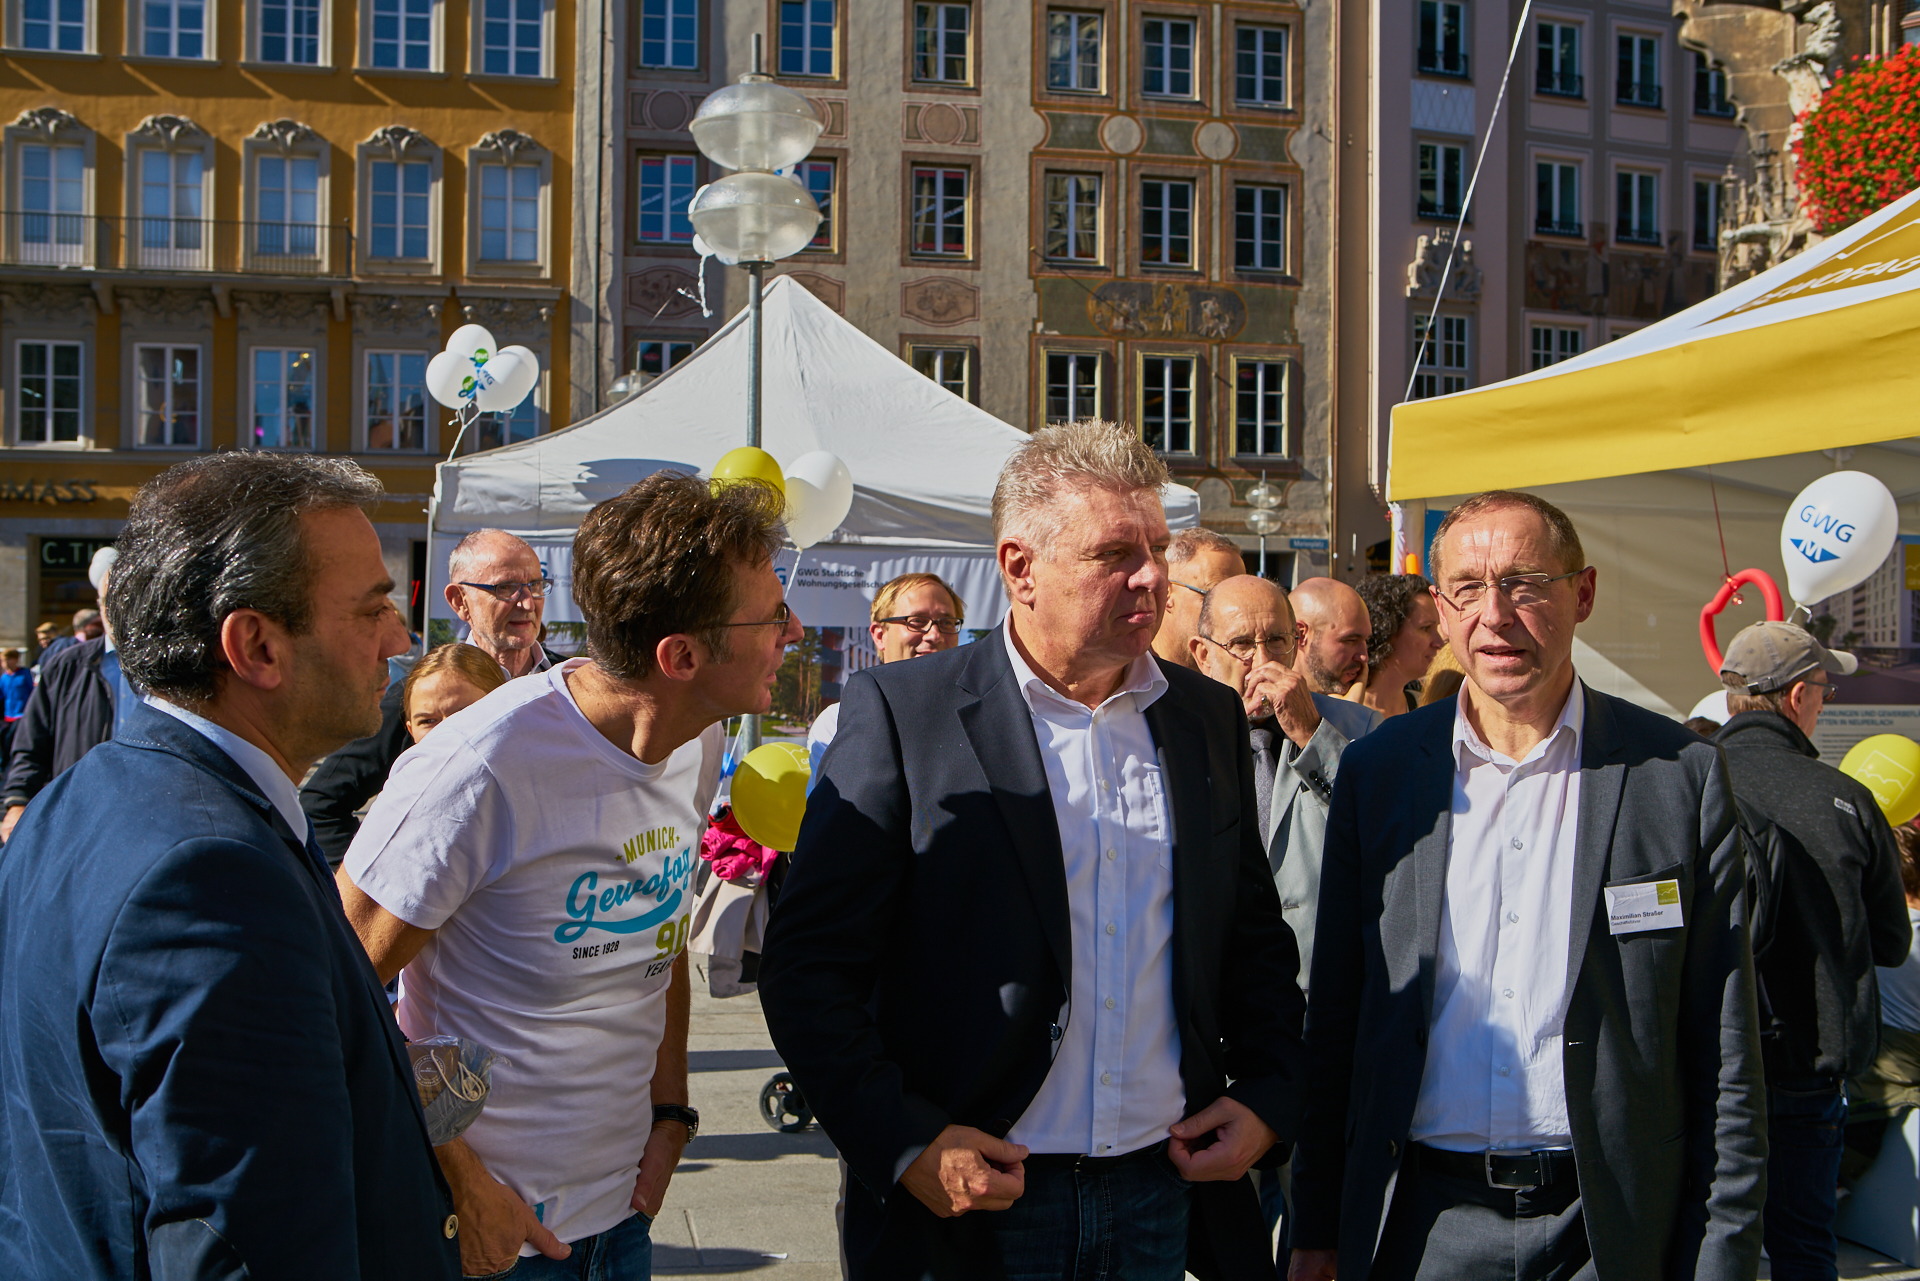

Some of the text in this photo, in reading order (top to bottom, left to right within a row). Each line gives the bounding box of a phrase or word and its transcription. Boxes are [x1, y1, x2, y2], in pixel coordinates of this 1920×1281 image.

[0, 479, 97, 502] MASS
[1800, 505, 1856, 543] GWG
[797, 568, 819, 577] GWG
[797, 579, 889, 590] Wohnungsgesellscha
[623, 826, 675, 864] MUNICH
[555, 846, 696, 943] Gewofag
[572, 940, 620, 960] SINCE 1928
[653, 912, 690, 961] 90
